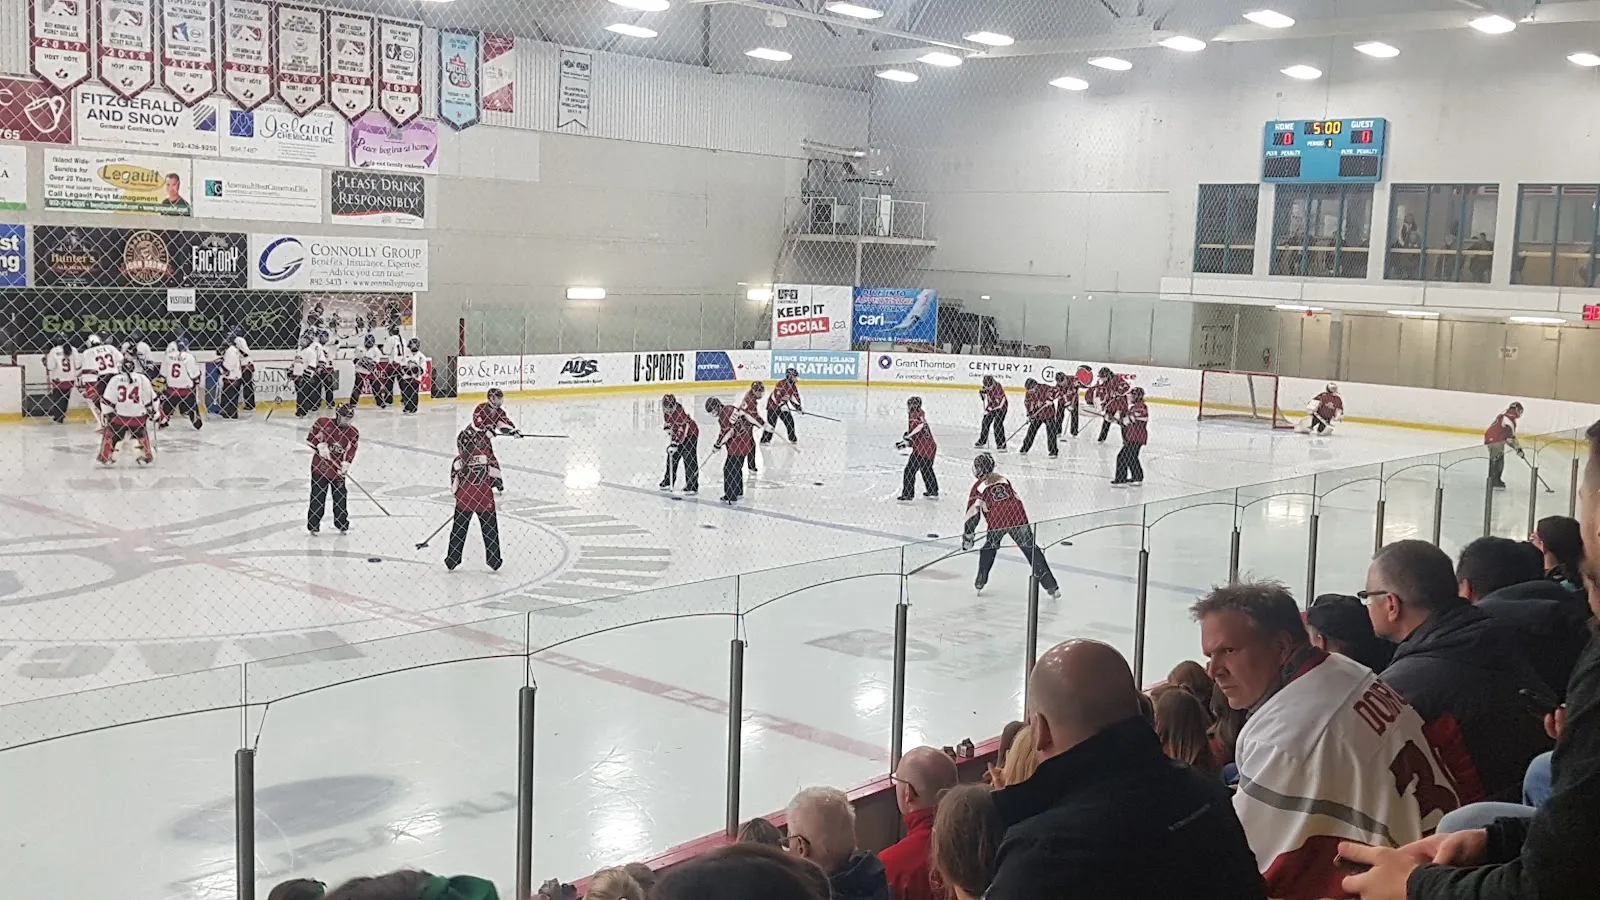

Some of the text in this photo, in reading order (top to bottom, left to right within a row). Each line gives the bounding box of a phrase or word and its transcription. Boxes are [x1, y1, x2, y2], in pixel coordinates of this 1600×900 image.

[41, 39, 81, 50] 2017
[108, 48, 146, 59] 2016
[82, 93, 183, 113] FITZGERALD
[87, 109, 179, 127] AND SNOW
[1351, 120, 1374, 128] GUEST
[99, 122, 165, 133] General Contractors
[260, 115, 334, 138] Island
[1275, 122, 1294, 130] HOME
[1313, 121, 1341, 134] 5:00
[277, 132, 319, 142] CHEMICALS
[1283, 133, 1292, 144] 0
[1361, 130, 1370, 143] 0
[357, 137, 376, 152] Peace
[379, 145, 402, 156] begins
[412, 143, 430, 151] home
[102, 165, 159, 184] Legault
[382, 178, 421, 193] DRINK
[65, 191, 93, 199] Legault
[95, 192, 111, 200] Pest
[113, 194, 158, 202] Management
[310, 243, 422, 259] CONNOLLY GROUP
[51, 253, 96, 263] Hunter's
[192, 246, 238, 272] FACTORY
[329, 268, 354, 276] Advice
[355, 270, 370, 278] you
[170, 296, 193, 304] VISITORS
[777, 304, 825, 318] KEEP IT
[42, 314, 224, 333] Go Panthers Go!
[859, 313, 884, 326] cari
[780, 321, 826, 334] SOCIAL
[62, 358, 71, 373] 9
[95, 353, 115, 371] 33
[477, 360, 490, 377] &
[560, 359, 599, 376] AUS
[895, 358, 956, 369] Grant Thornton
[969, 362, 1033, 373] CENTURY 21
[171, 363, 181, 378] 6
[1046, 370, 1054, 378] 21
[117, 385, 140, 404] 34
